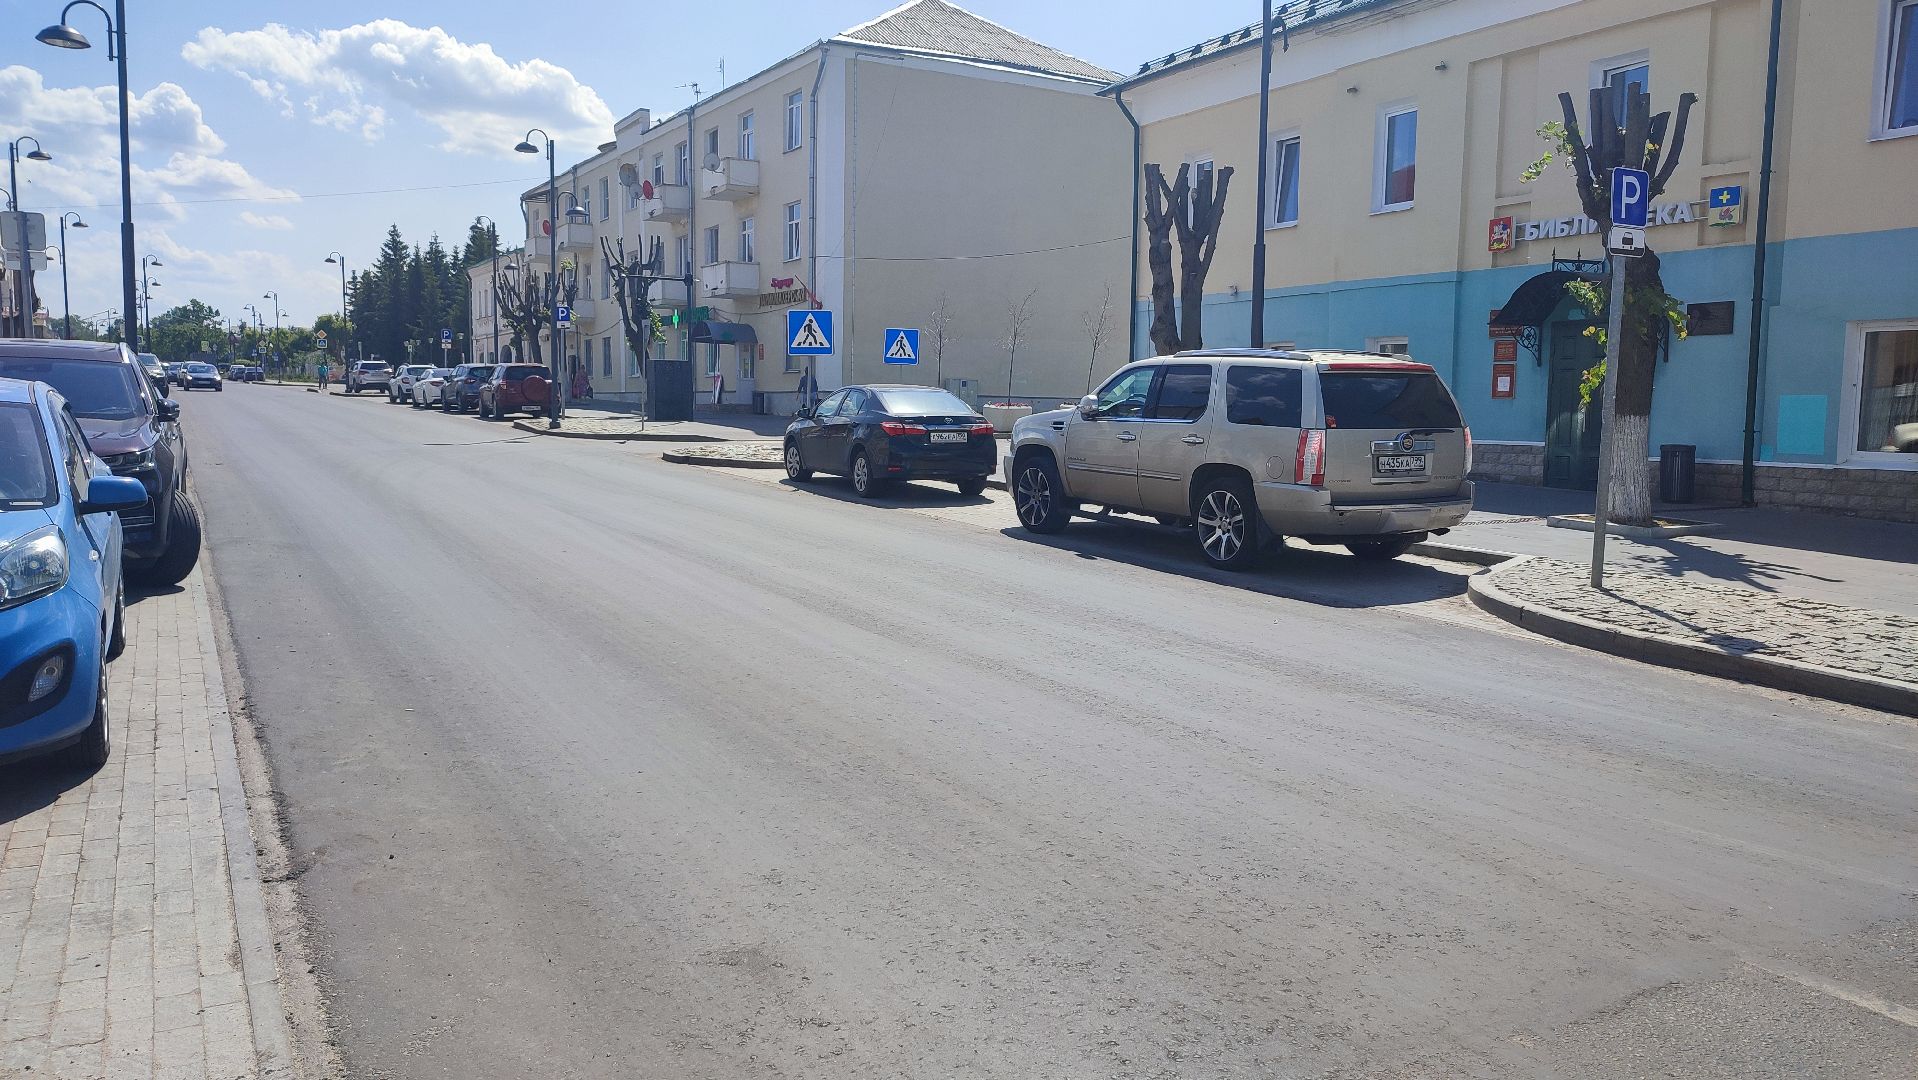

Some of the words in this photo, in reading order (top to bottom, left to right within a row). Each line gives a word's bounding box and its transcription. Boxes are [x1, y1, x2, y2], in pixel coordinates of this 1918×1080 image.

[1621, 175, 1641, 219] P
[1523, 200, 1696, 241] БИБЛИКА
[558, 307, 568, 321] P
[443, 330, 450, 339] P
